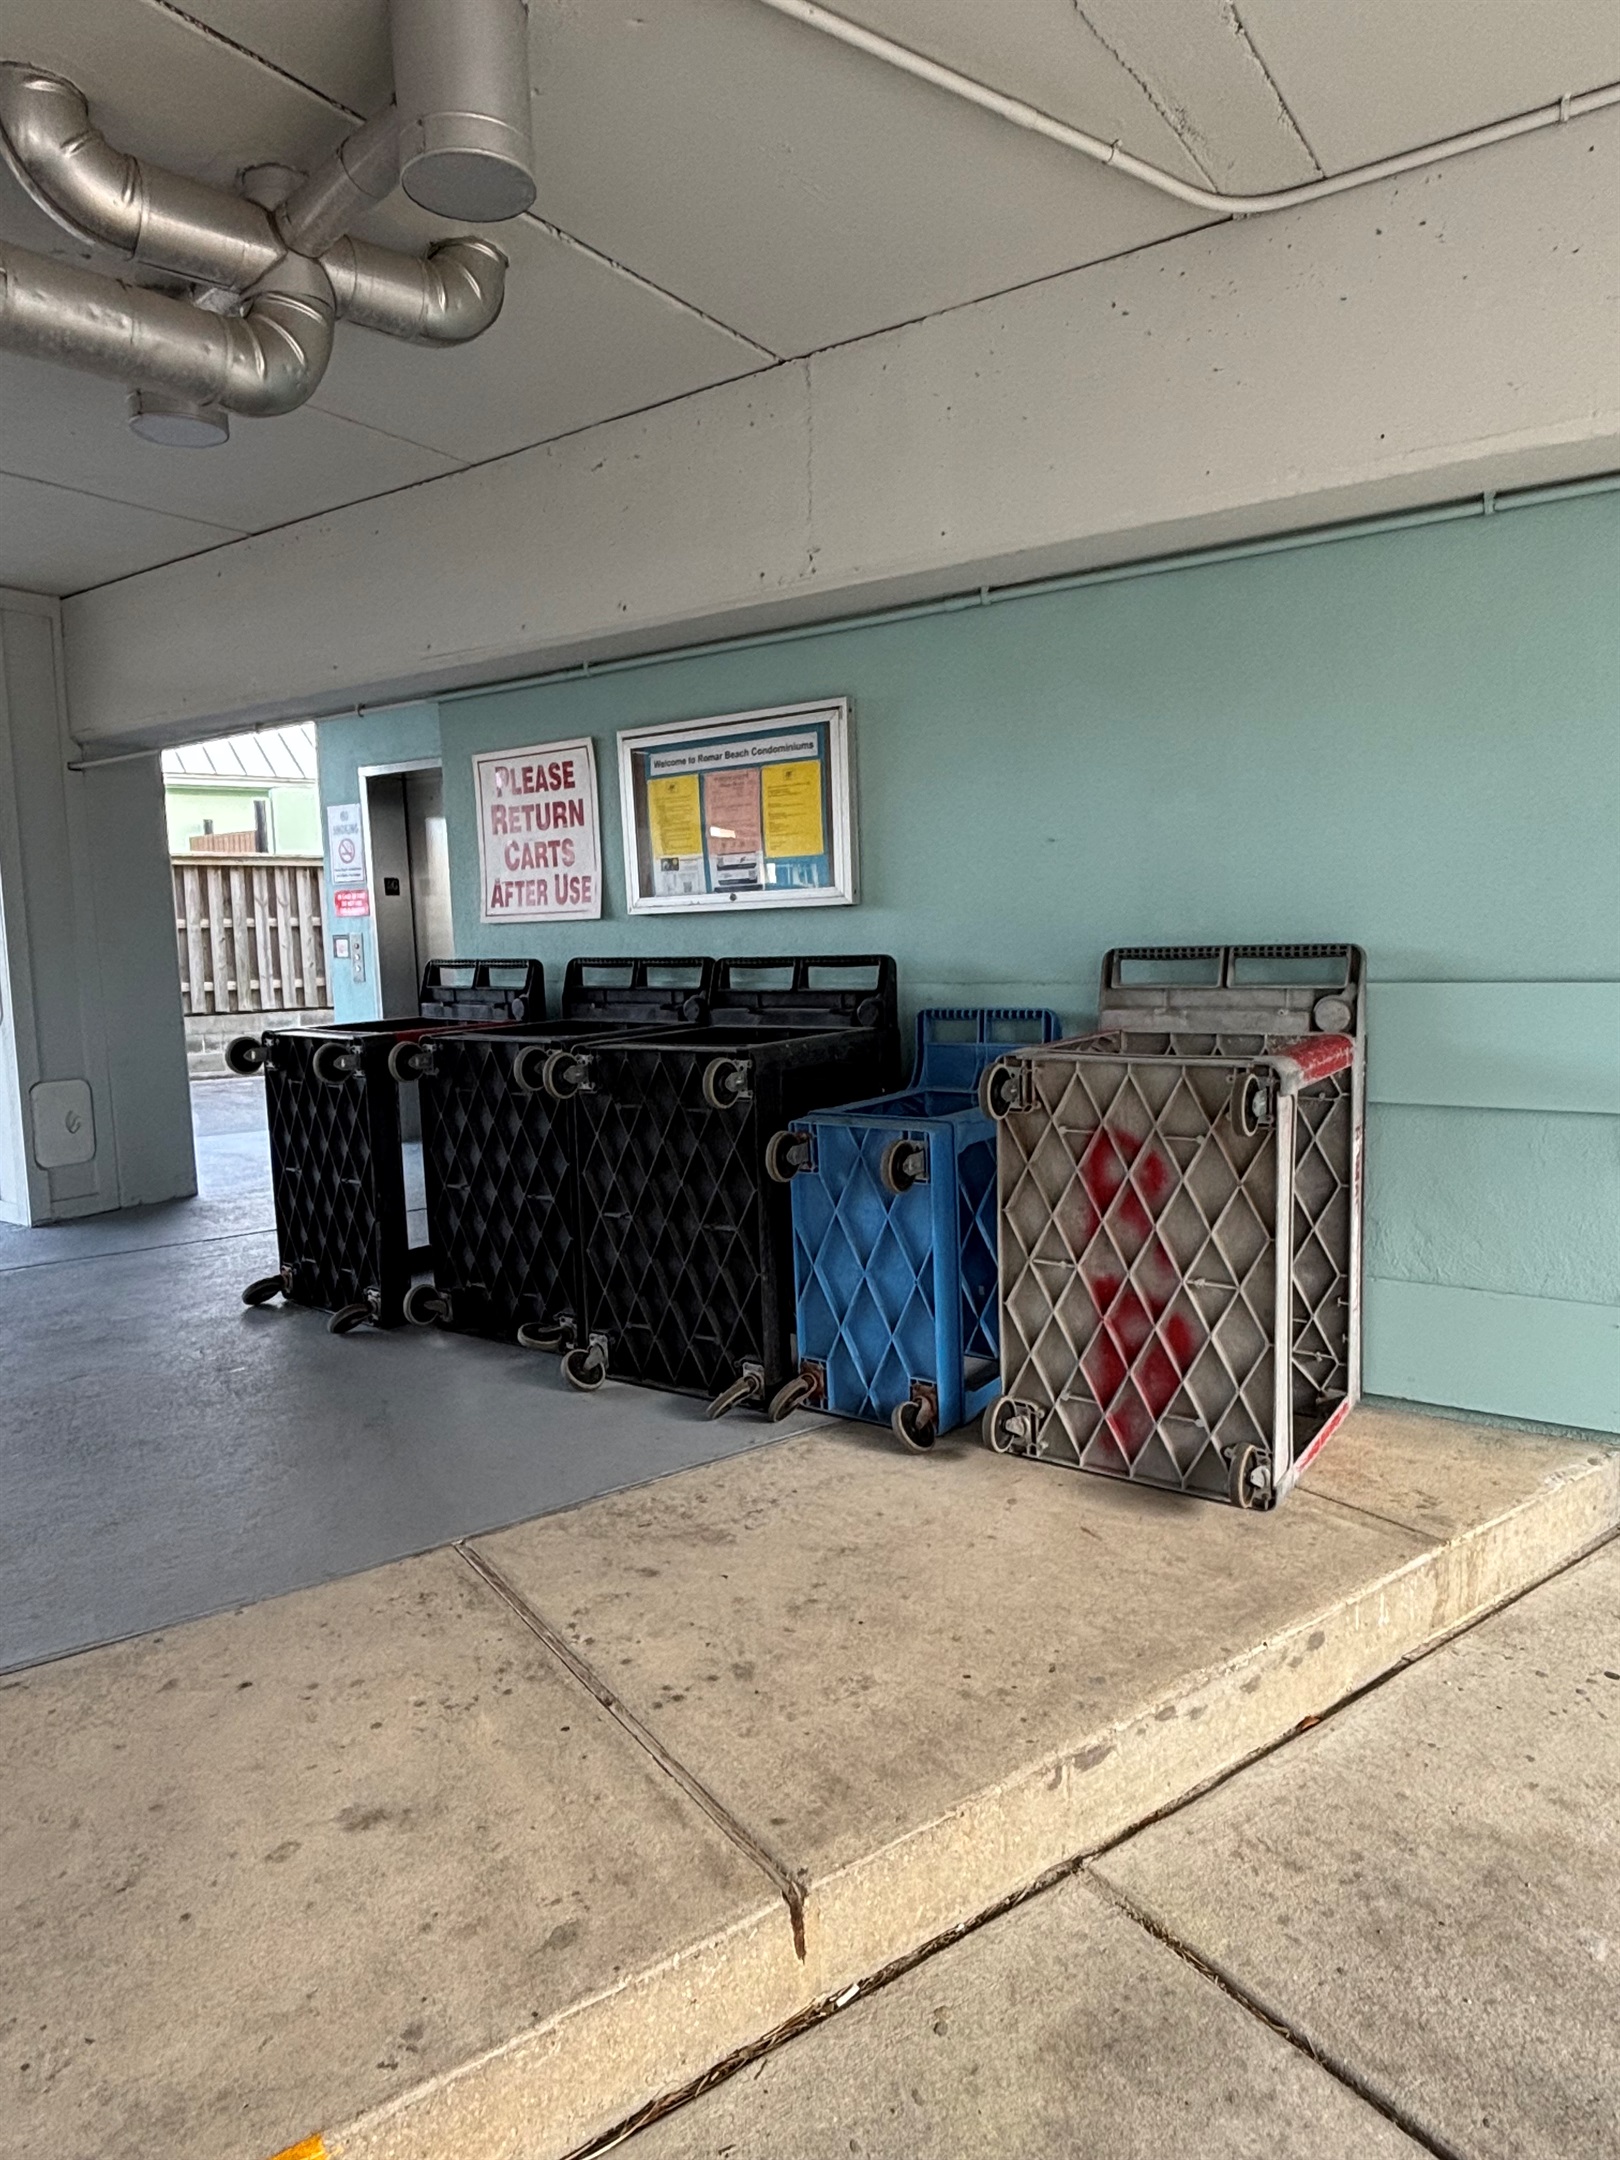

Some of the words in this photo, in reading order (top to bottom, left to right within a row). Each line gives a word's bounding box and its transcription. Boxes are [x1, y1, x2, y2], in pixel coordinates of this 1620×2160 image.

[653, 756, 686, 769] Welcome
[688, 756, 696, 765] to
[697, 753, 723, 764] Romar
[725, 748, 749, 760] Beach
[751, 741, 814, 756] Condominiums
[494, 760, 576, 798] PLEASE
[490, 798, 585, 835] RETURN
[504, 838, 576, 871] CARTS
[490, 878, 548, 908] AFTER
[554, 873, 592, 905] USE
